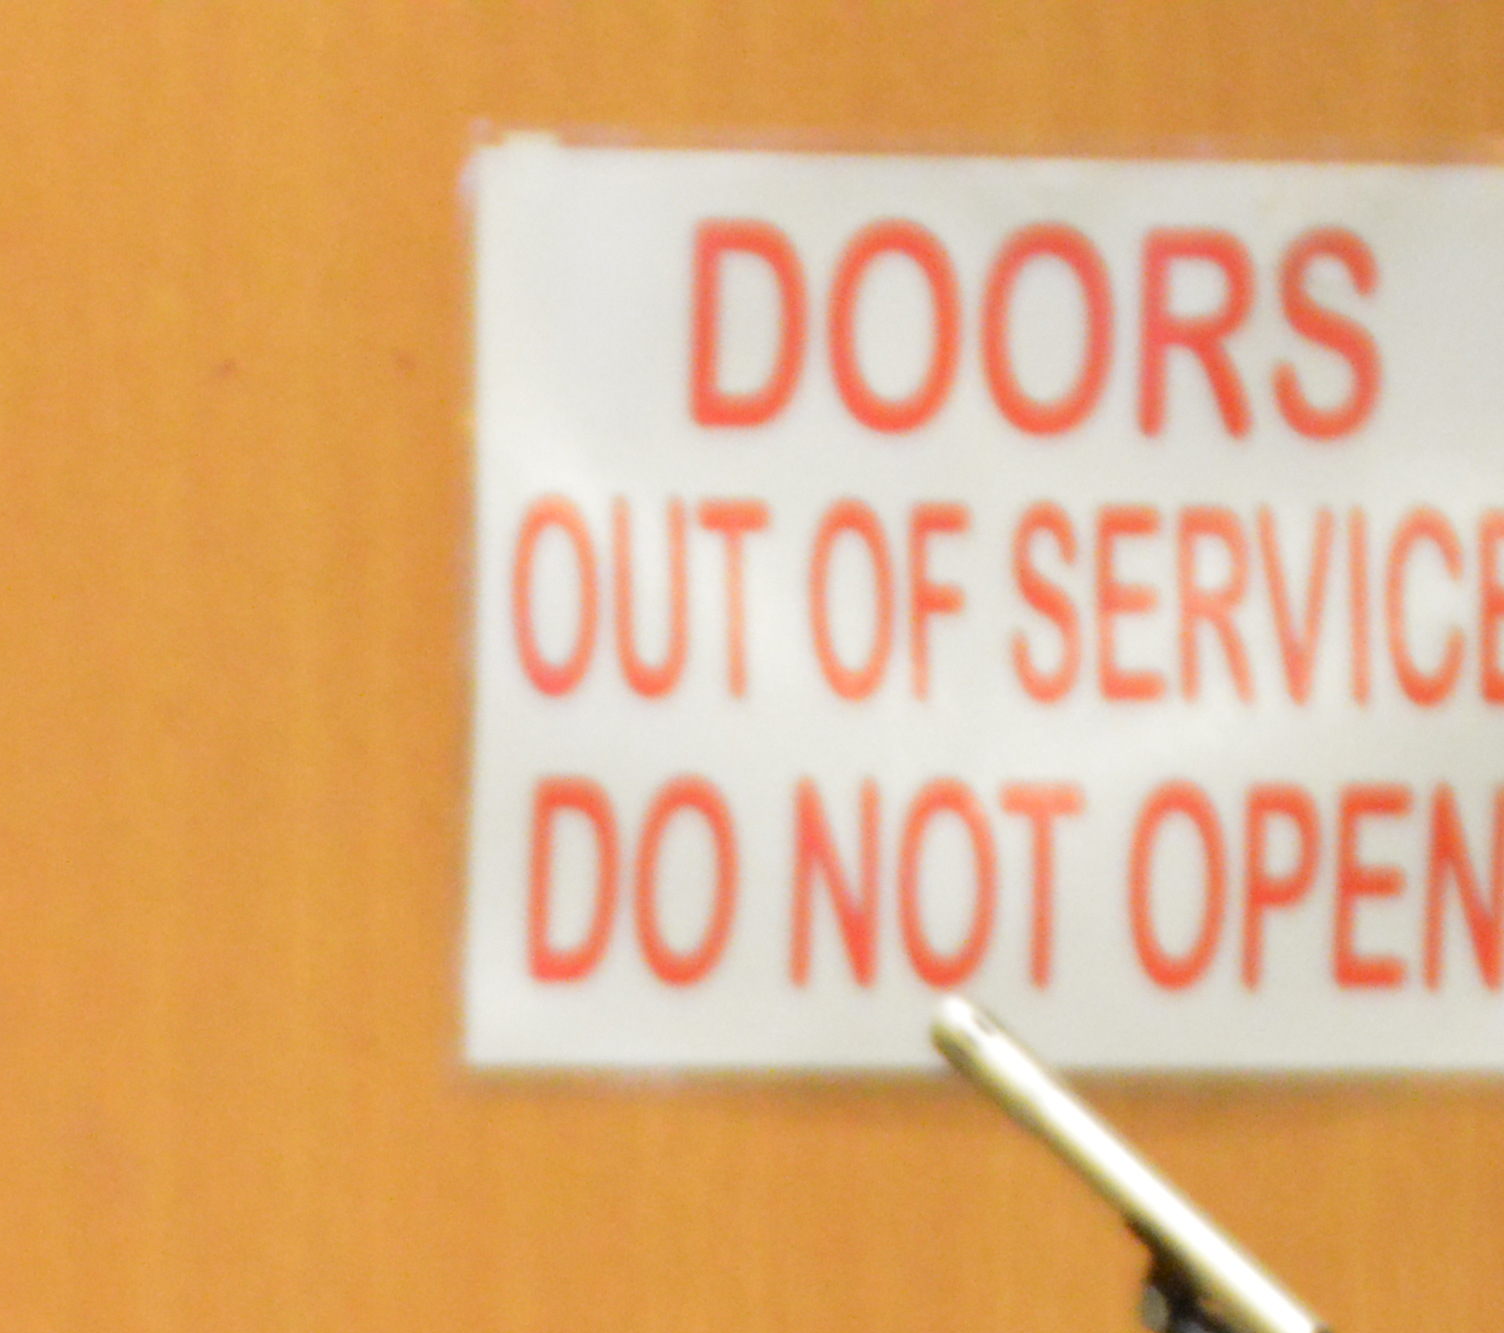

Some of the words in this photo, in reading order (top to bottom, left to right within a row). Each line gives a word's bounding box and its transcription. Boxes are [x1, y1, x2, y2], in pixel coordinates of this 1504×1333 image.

[684, 216, 1385, 444] DOORS
[509, 495, 772, 702] OUT
[806, 497, 973, 704] OF
[524, 773, 743, 991] DO
[786, 776, 1086, 994] NOT
